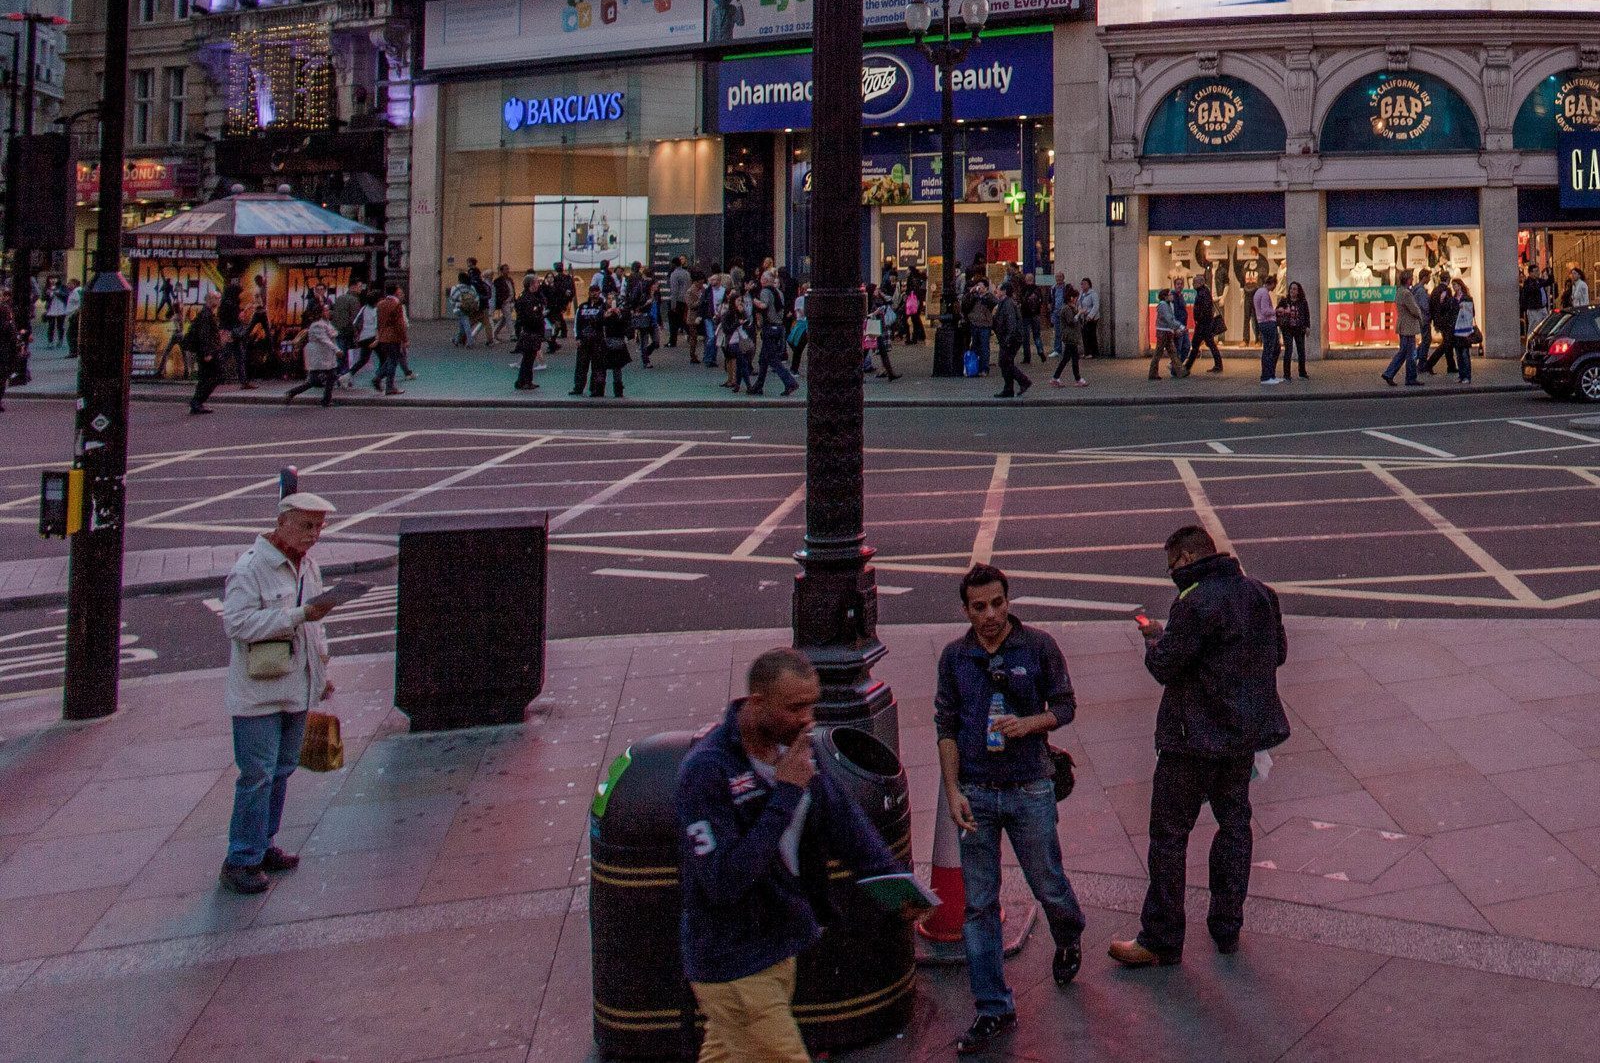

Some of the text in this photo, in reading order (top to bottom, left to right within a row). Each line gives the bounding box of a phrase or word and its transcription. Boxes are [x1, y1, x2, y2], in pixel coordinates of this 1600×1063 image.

[728, 79, 813, 112] pharmac
[526, 91, 625, 126] BARCLAYS
[1197, 100, 1236, 125] GAP
[1380, 95, 1423, 120] GAP
[1204, 122, 1228, 131] 1969
[1388, 117, 1414, 126] 1969
[1408, 114, 1432, 139] EDITION
[1571, 115, 1595, 125] 1969
[1188, 119, 1244, 145] LONDON EDITION
[921, 177, 943, 187] midni
[921, 188, 943, 198] pharm
[1110, 201, 1124, 221] GAP
[129, 248, 152, 259] HALF
[152, 249, 177, 259] PRICE
[1335, 291, 1346, 300] UP
[1349, 290, 1358, 299] TO
[1361, 289, 1382, 299] 50%
[1336, 312, 1394, 331] SALE
[686, 819, 717, 855] 3
